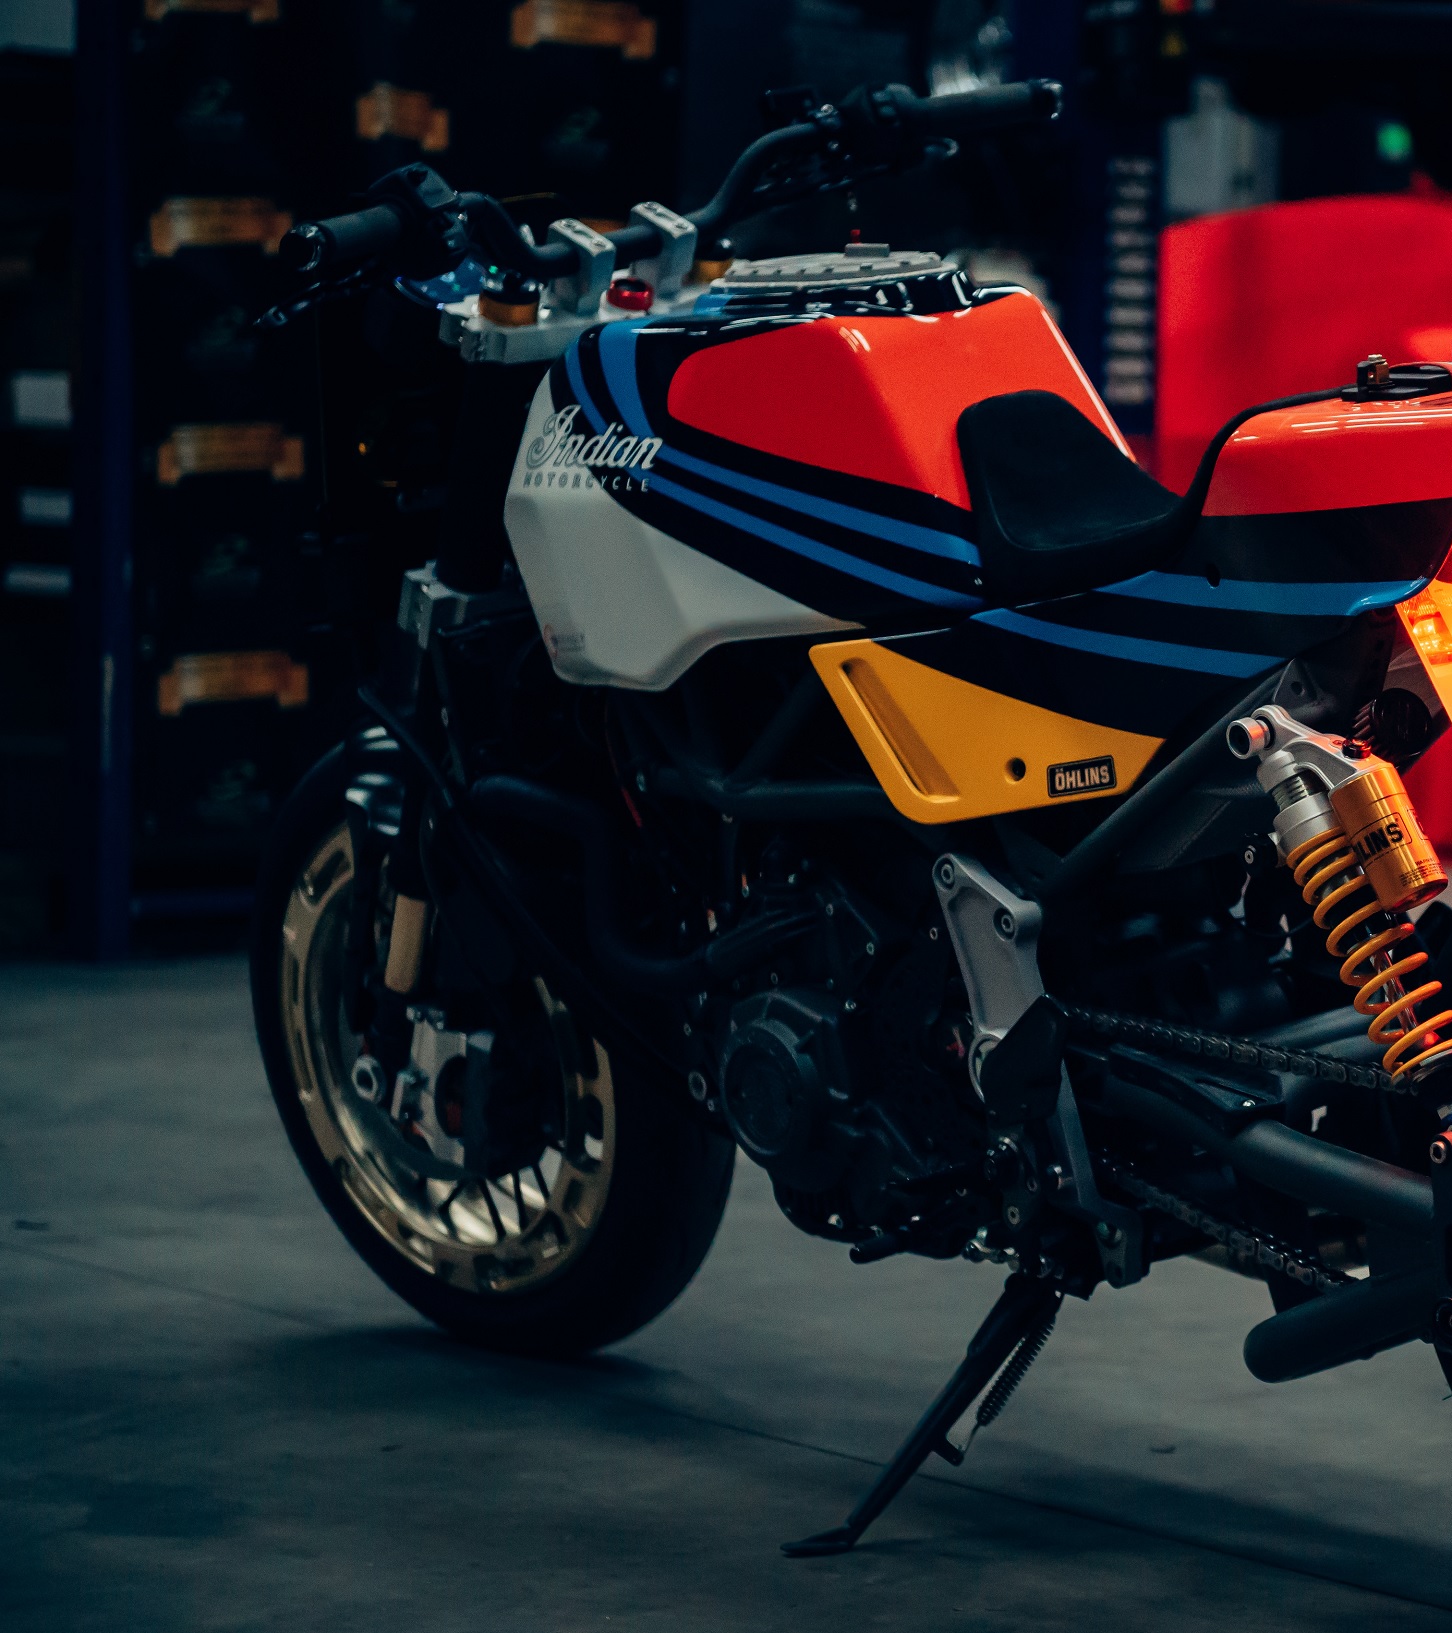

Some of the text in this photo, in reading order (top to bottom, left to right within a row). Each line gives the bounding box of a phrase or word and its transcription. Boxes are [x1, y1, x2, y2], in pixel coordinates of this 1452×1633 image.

[526, 404, 663, 470] Indian
[523, 471, 649, 492] MOTORCYCLE
[1055, 765, 1110, 791] ÖHLINS
